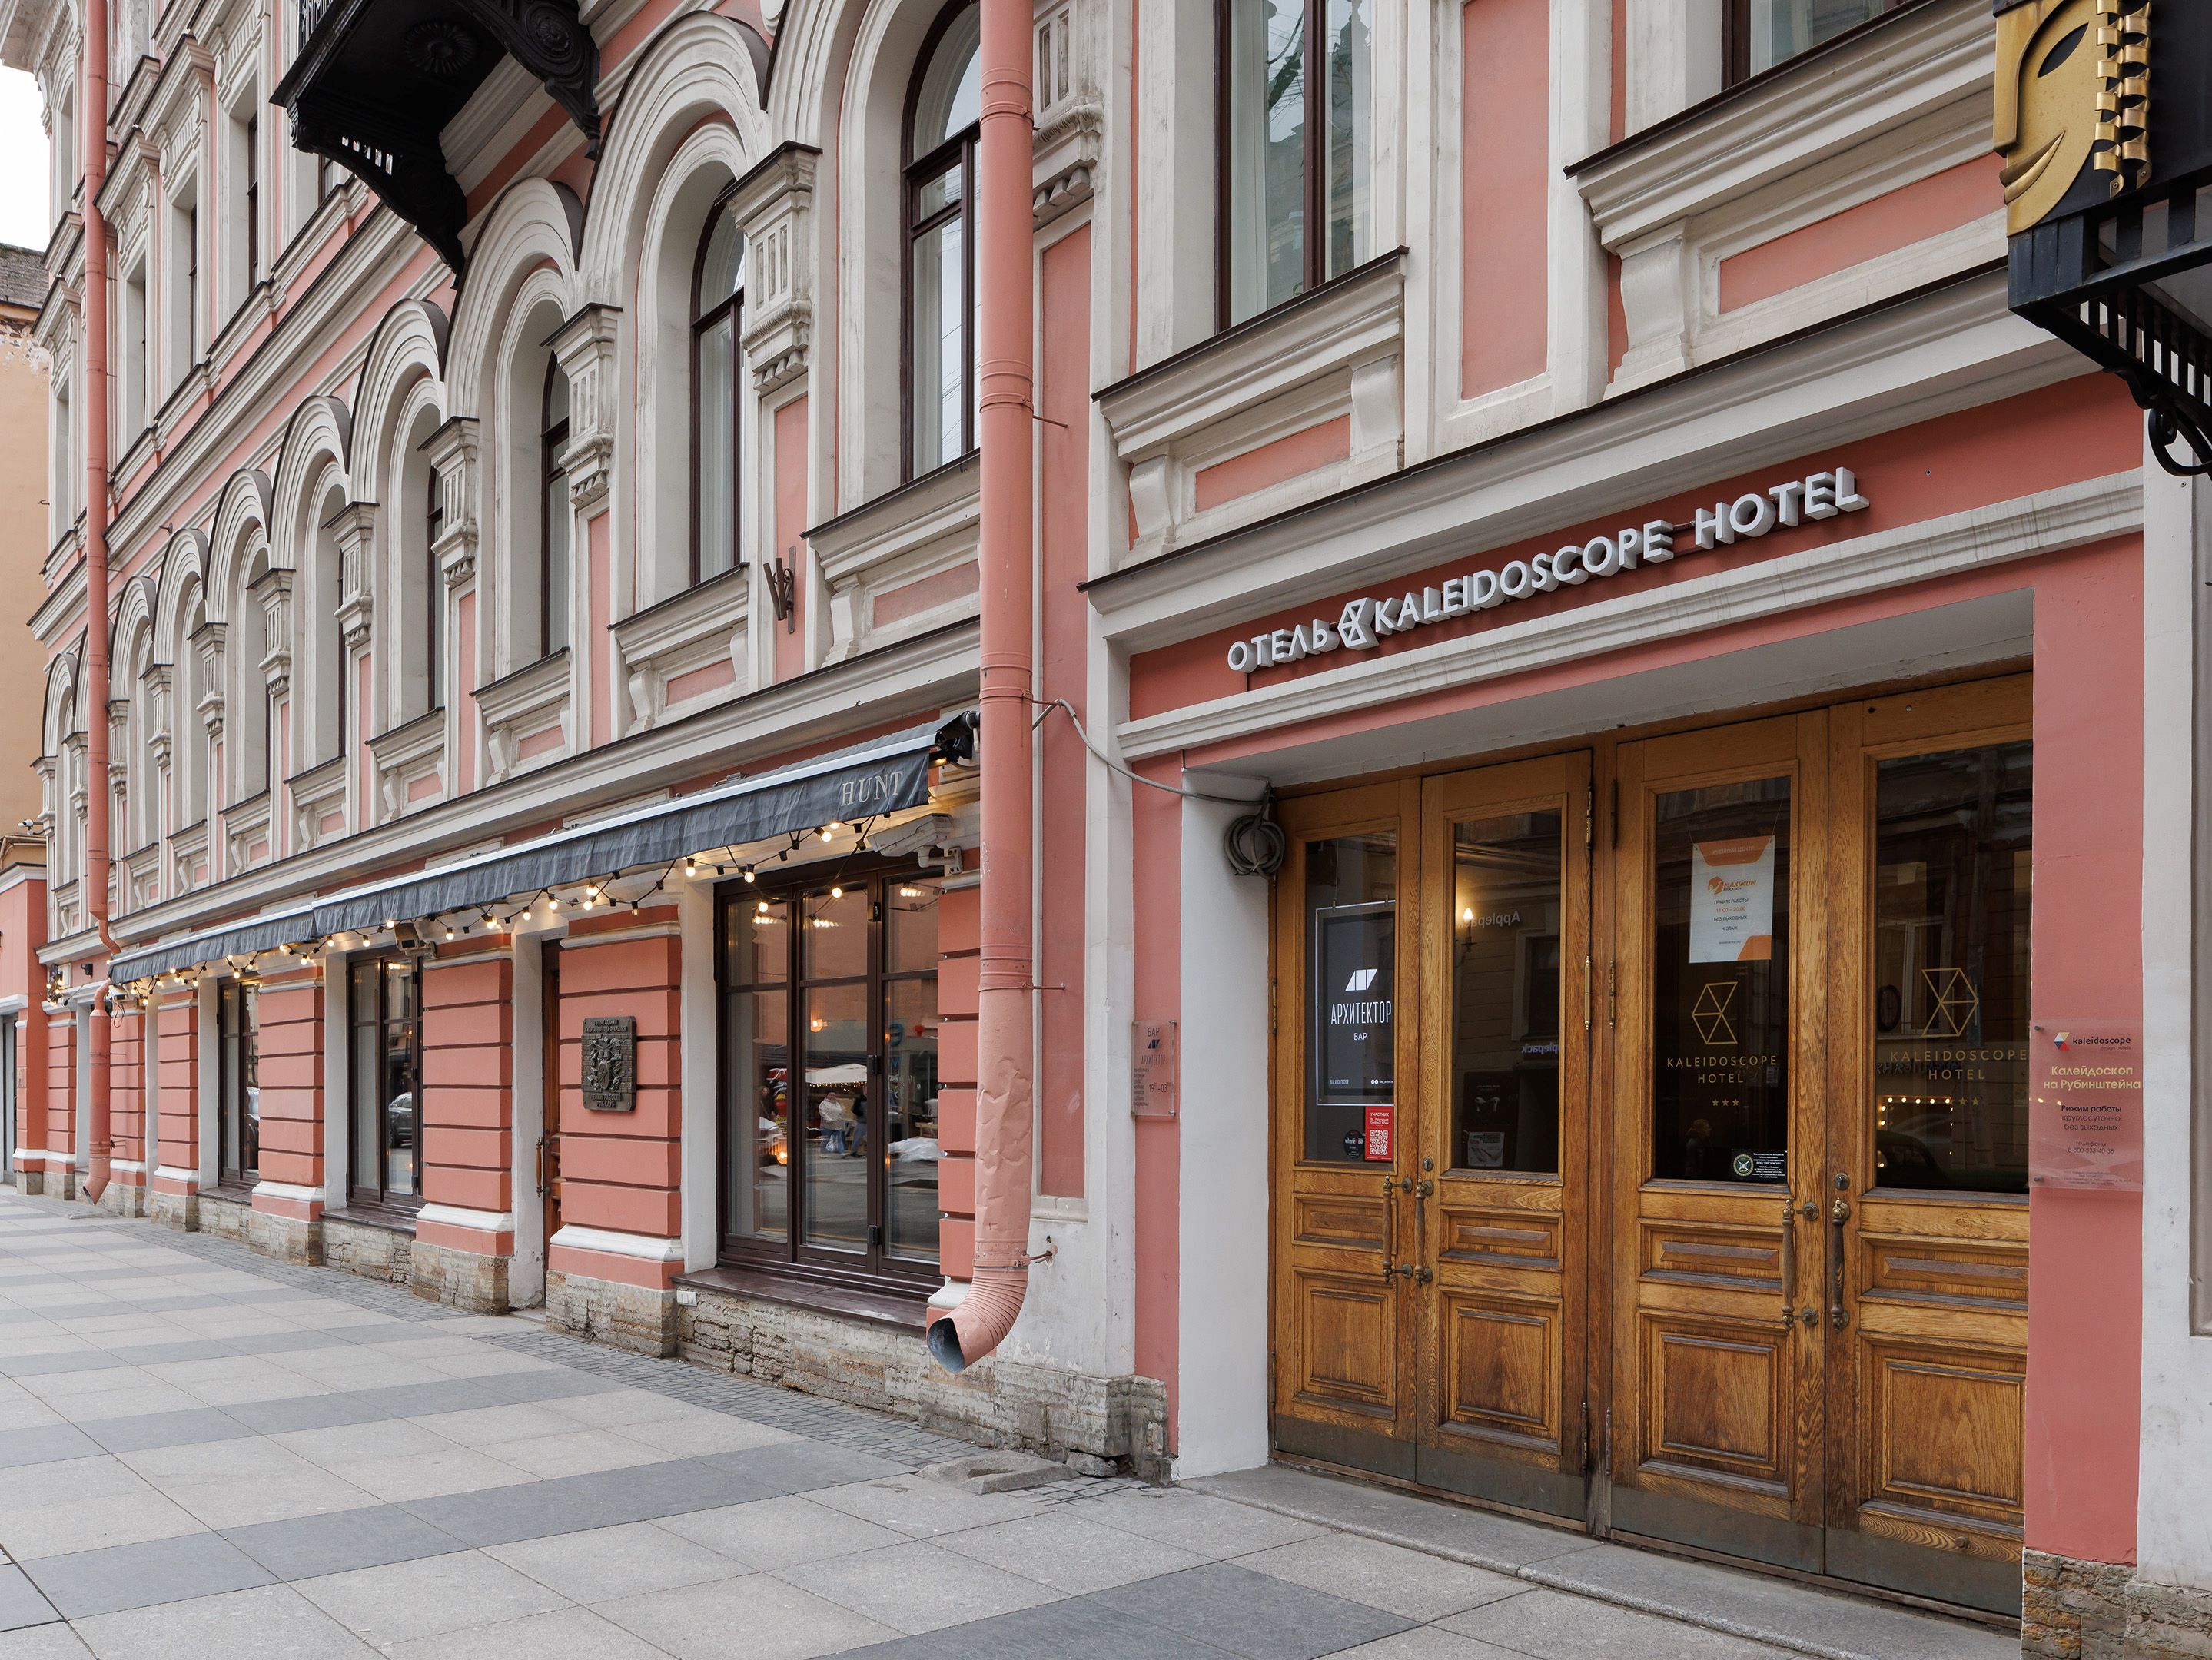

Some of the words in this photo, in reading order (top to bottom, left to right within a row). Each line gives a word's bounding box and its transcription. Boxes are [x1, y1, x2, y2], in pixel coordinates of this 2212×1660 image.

[1227, 619, 1334, 672] ОТЕЛЬ
[1375, 520, 1669, 636] KALEIDOSCOPE
[1696, 467, 1865, 549] HOTEL
[841, 770, 903, 807] HUNT
[1722, 880, 1757, 888] MAXIMUM
[1330, 1001, 1392, 1025] АРХИТЕКТОР
[1147, 1027, 1160, 1037] БАР
[1353, 1032, 1367, 1041] БАР
[2072, 1036, 2131, 1046] kaleidoscope
[1890, 1050, 2028, 1061] KALEIDOSCOPE
[1667, 1055, 1777, 1068] KALEIDOSCOPE
[1928, 1069, 1985, 1080] HOTEL
[2051, 1065, 2133, 1077] Калейдоскоп
[1697, 1073, 1744, 1084] HOTEL
[2044, 1081, 2058, 1090] на
[2061, 1079, 2141, 1091] Рубинштейна
